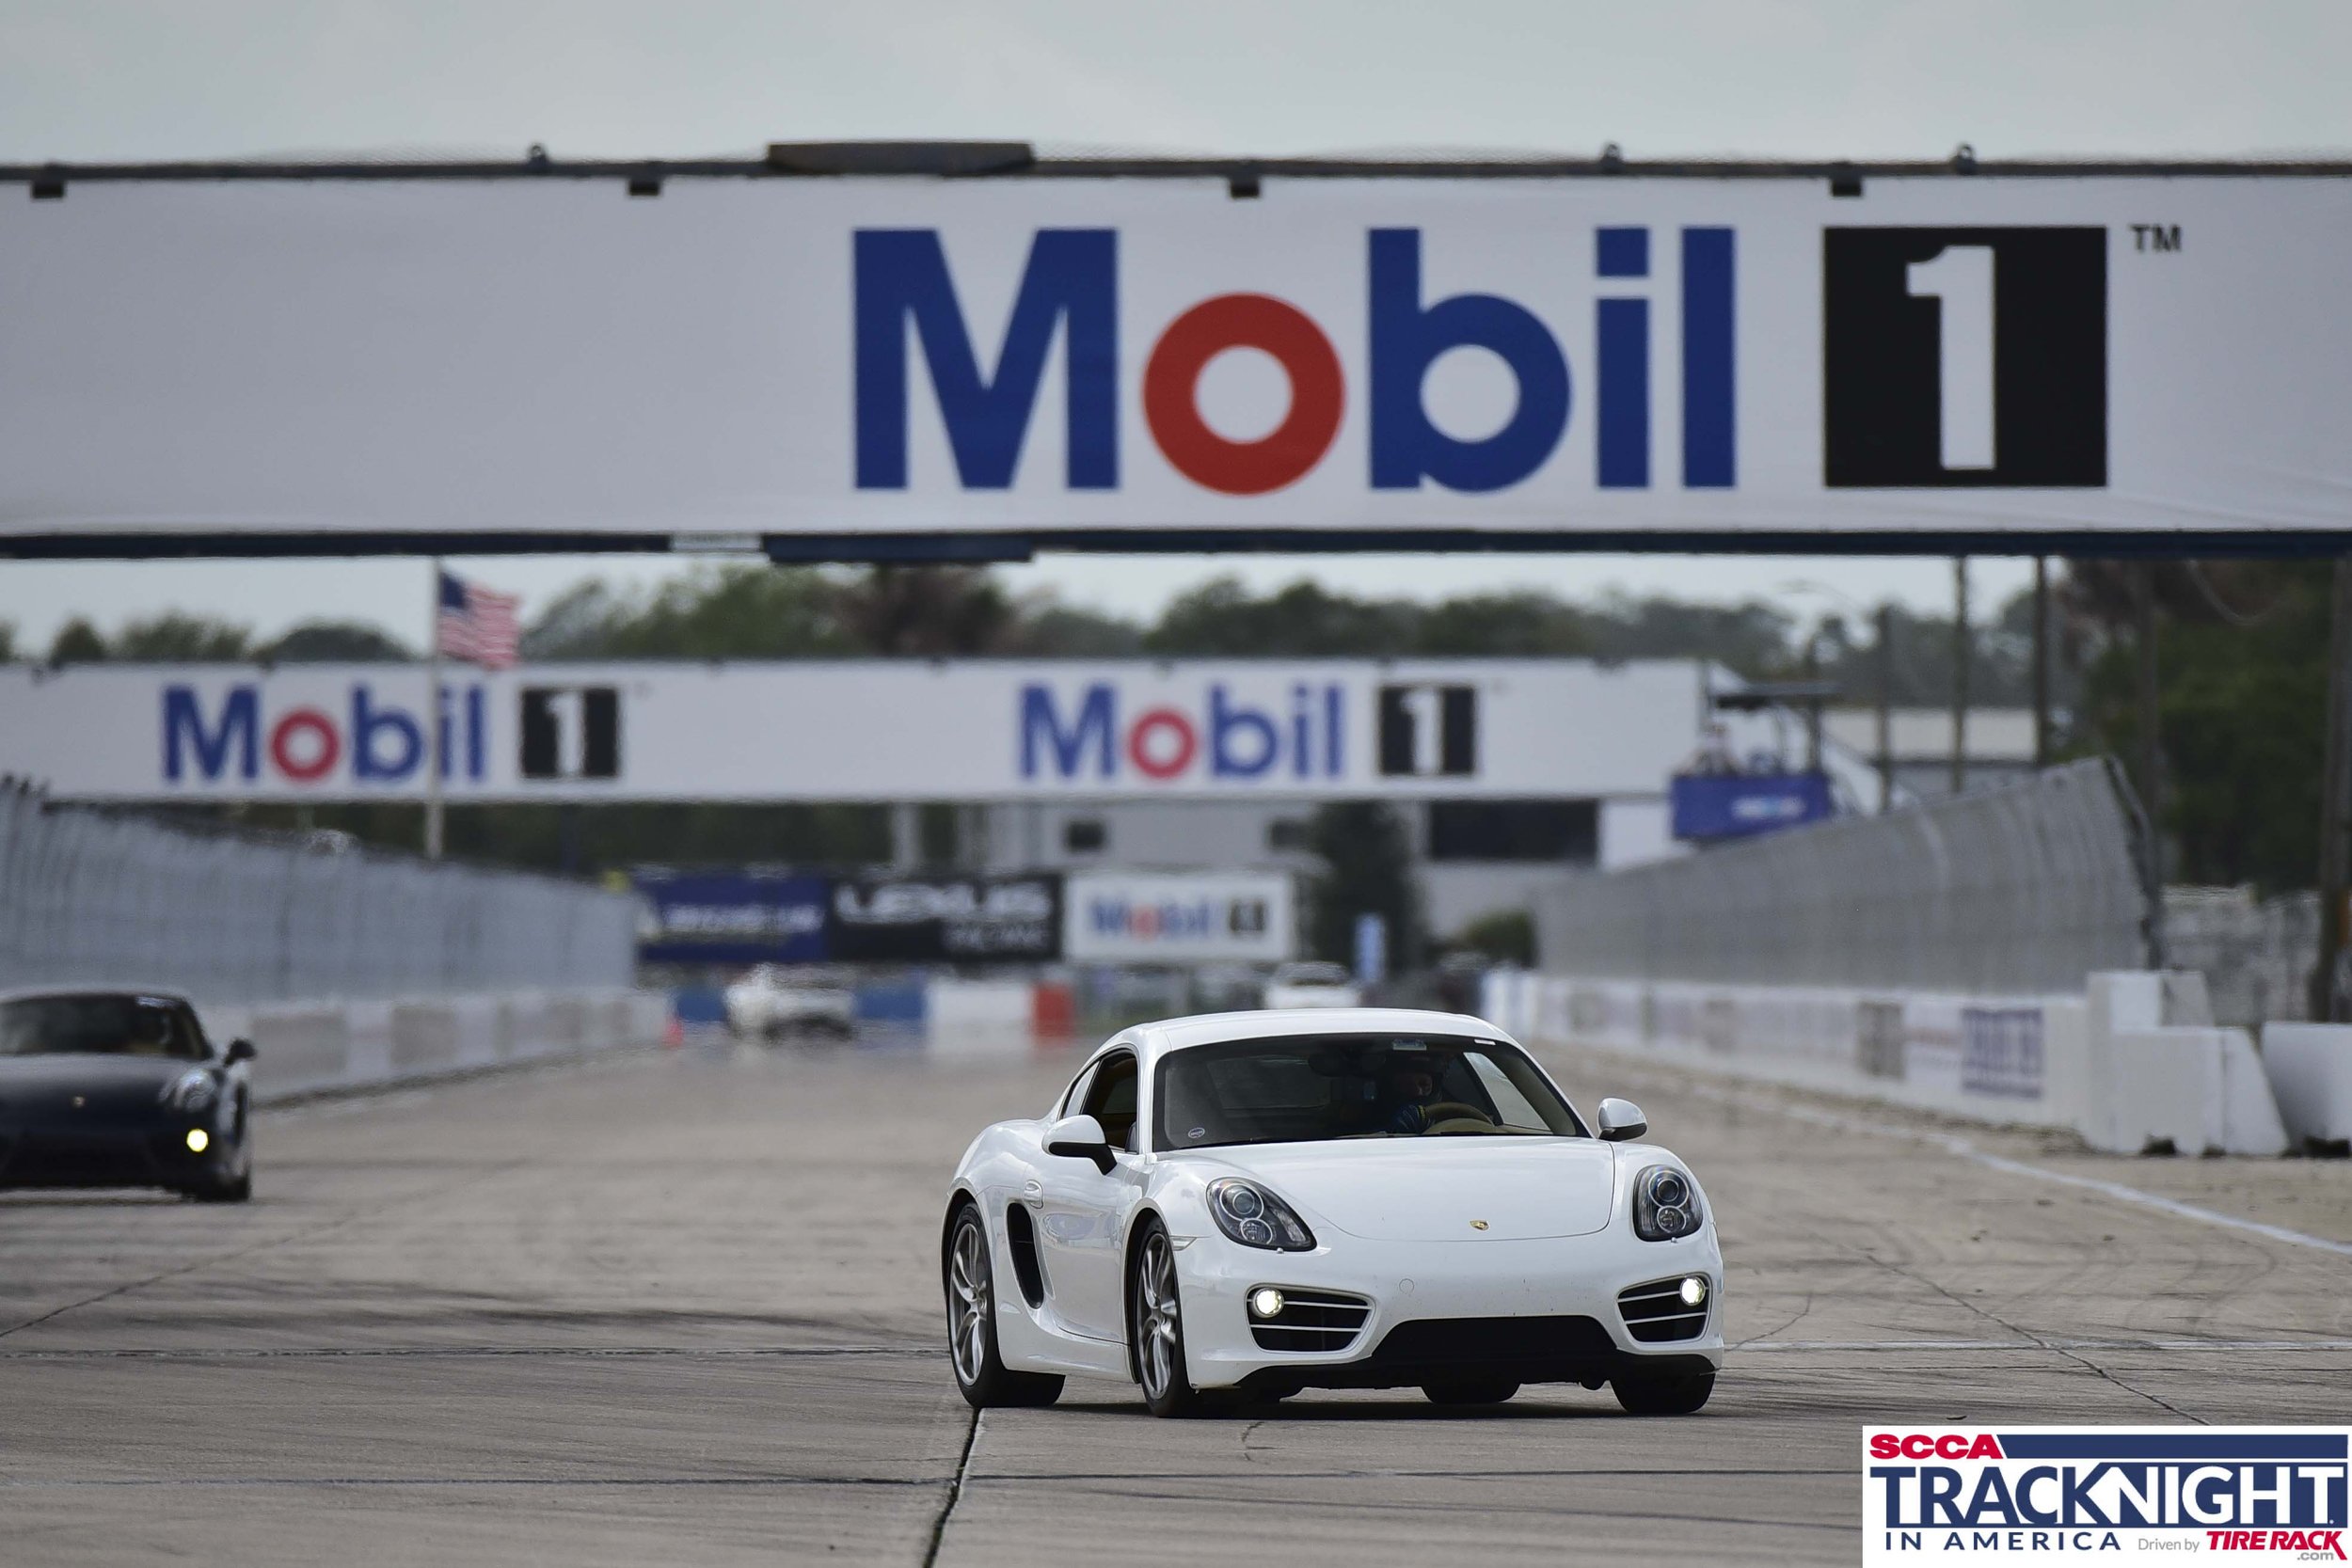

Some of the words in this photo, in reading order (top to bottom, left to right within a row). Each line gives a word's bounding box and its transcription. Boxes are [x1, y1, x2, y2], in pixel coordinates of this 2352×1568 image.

[852, 228, 1738, 495] Mobil
[2130, 223, 2181, 253] TM
[162, 684, 485, 784] Mobil
[1019, 682, 1343, 780] Mobil
